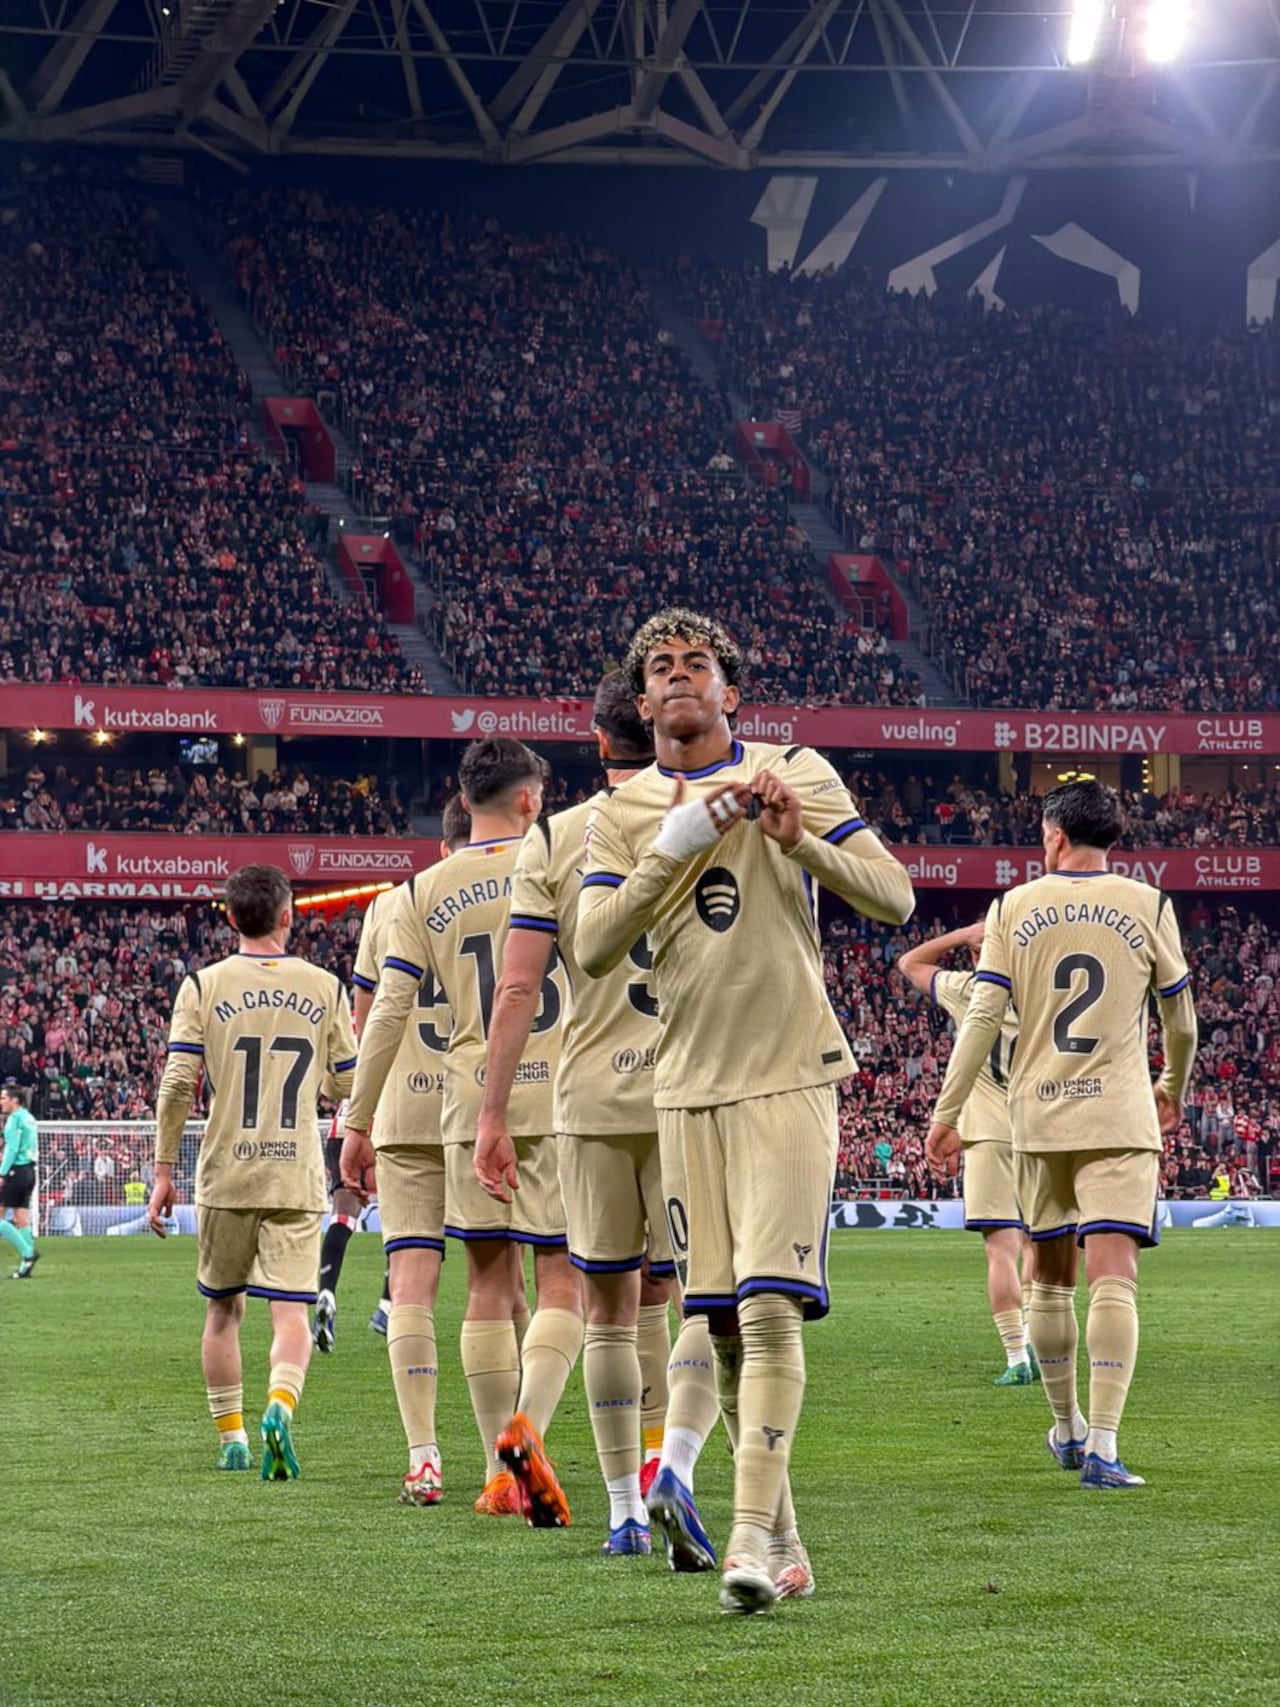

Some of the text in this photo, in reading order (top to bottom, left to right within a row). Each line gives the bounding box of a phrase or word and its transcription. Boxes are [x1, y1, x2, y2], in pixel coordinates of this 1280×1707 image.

[104, 706, 217, 728] kutxabank
[290, 708, 384, 723] FUNDAZIOA
[881, 718, 961, 746] vueling
[1024, 723, 1167, 751] B2BINPAY
[1197, 719, 1263, 738] CLUB
[116, 854, 229, 875] kutxabank
[319, 853, 413, 868] FUNDAZIOA
[1194, 855, 1260, 873] CLUB
[426, 878, 499, 935] GERARD
[1012, 903, 1146, 950] JOÃO CANCELO
[215, 990, 327, 1026] M. CASADÓ
[1053, 952, 1106, 1055] 2
[232, 1035, 315, 1130] 17
[259, 1140, 297, 1150] UNHCR
[259, 1149, 297, 1159] ACNUR
